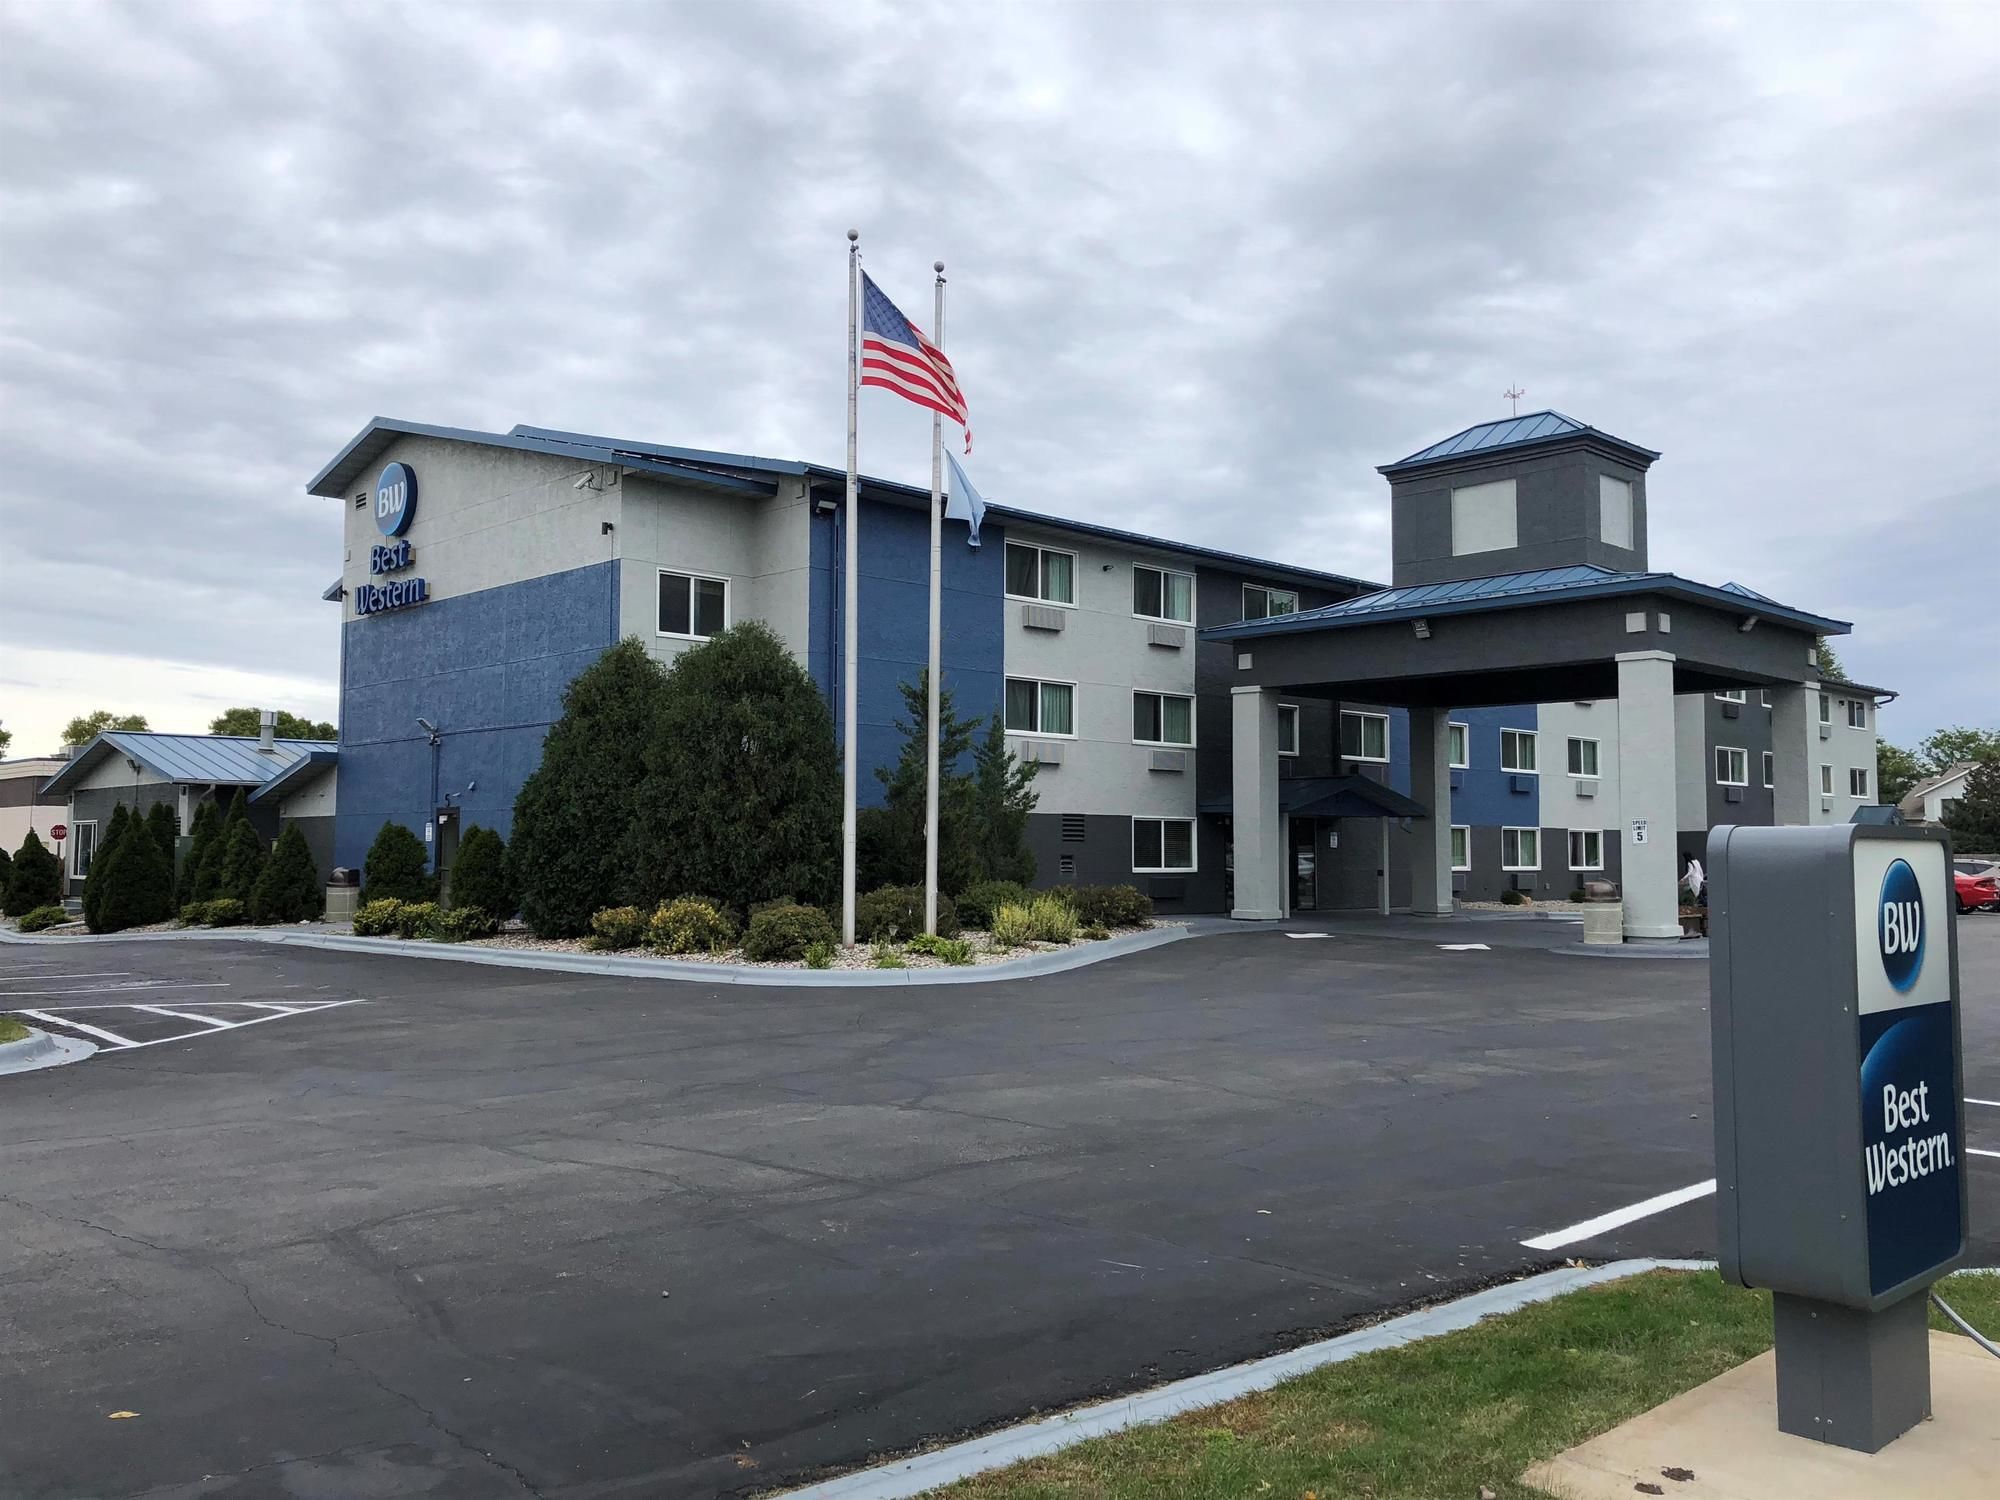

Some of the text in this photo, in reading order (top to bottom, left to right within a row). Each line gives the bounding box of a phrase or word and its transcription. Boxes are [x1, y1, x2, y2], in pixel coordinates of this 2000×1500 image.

[378, 481, 405, 518] BW
[371, 540, 406, 574] Best
[355, 578, 421, 614] Western
[1637, 831, 1643, 841] 5
[1884, 901, 1920, 955] BW
[1883, 1080, 1930, 1133] Best
[1865, 1132, 1951, 1195] Western
